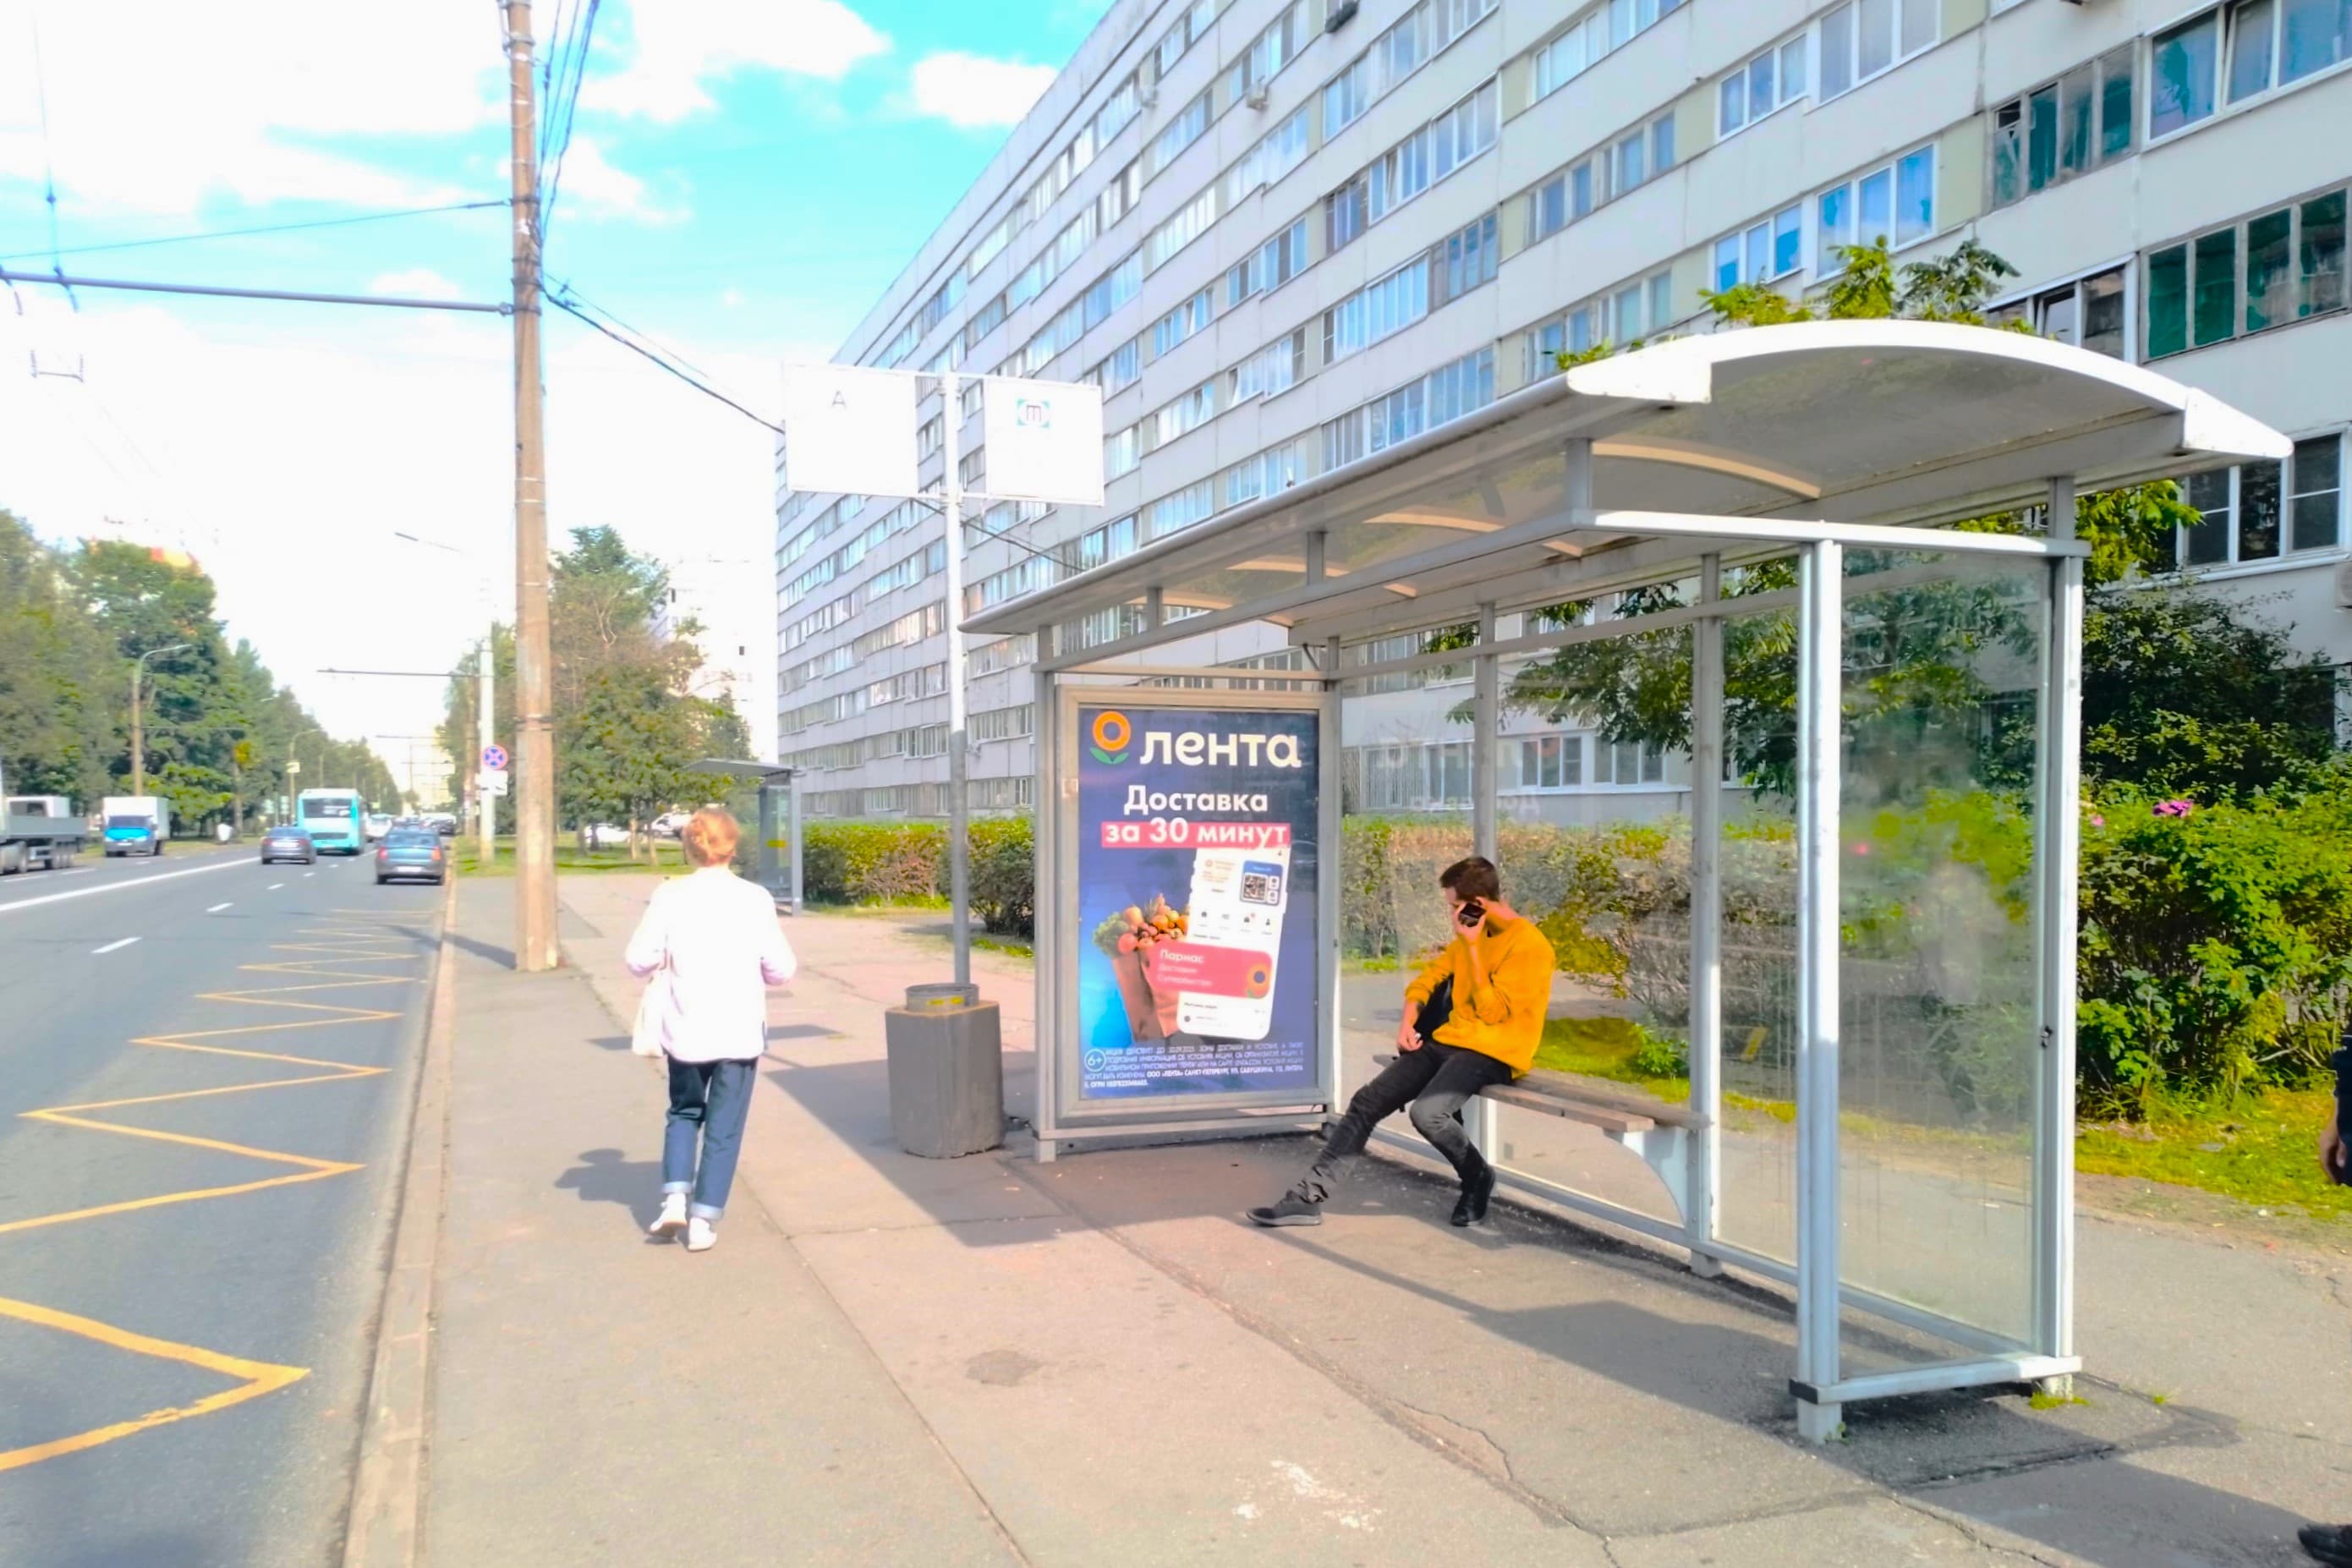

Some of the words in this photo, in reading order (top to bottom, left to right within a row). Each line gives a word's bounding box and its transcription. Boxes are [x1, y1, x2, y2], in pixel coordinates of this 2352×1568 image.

[1139, 731, 1302, 768] лента
[1123, 784, 1268, 815] Доставка
[1105, 825, 1140, 843] за
[1149, 817, 1188, 843] 30
[1197, 825, 1288, 849] минут
[1088, 1056, 1103, 1066] 6+
